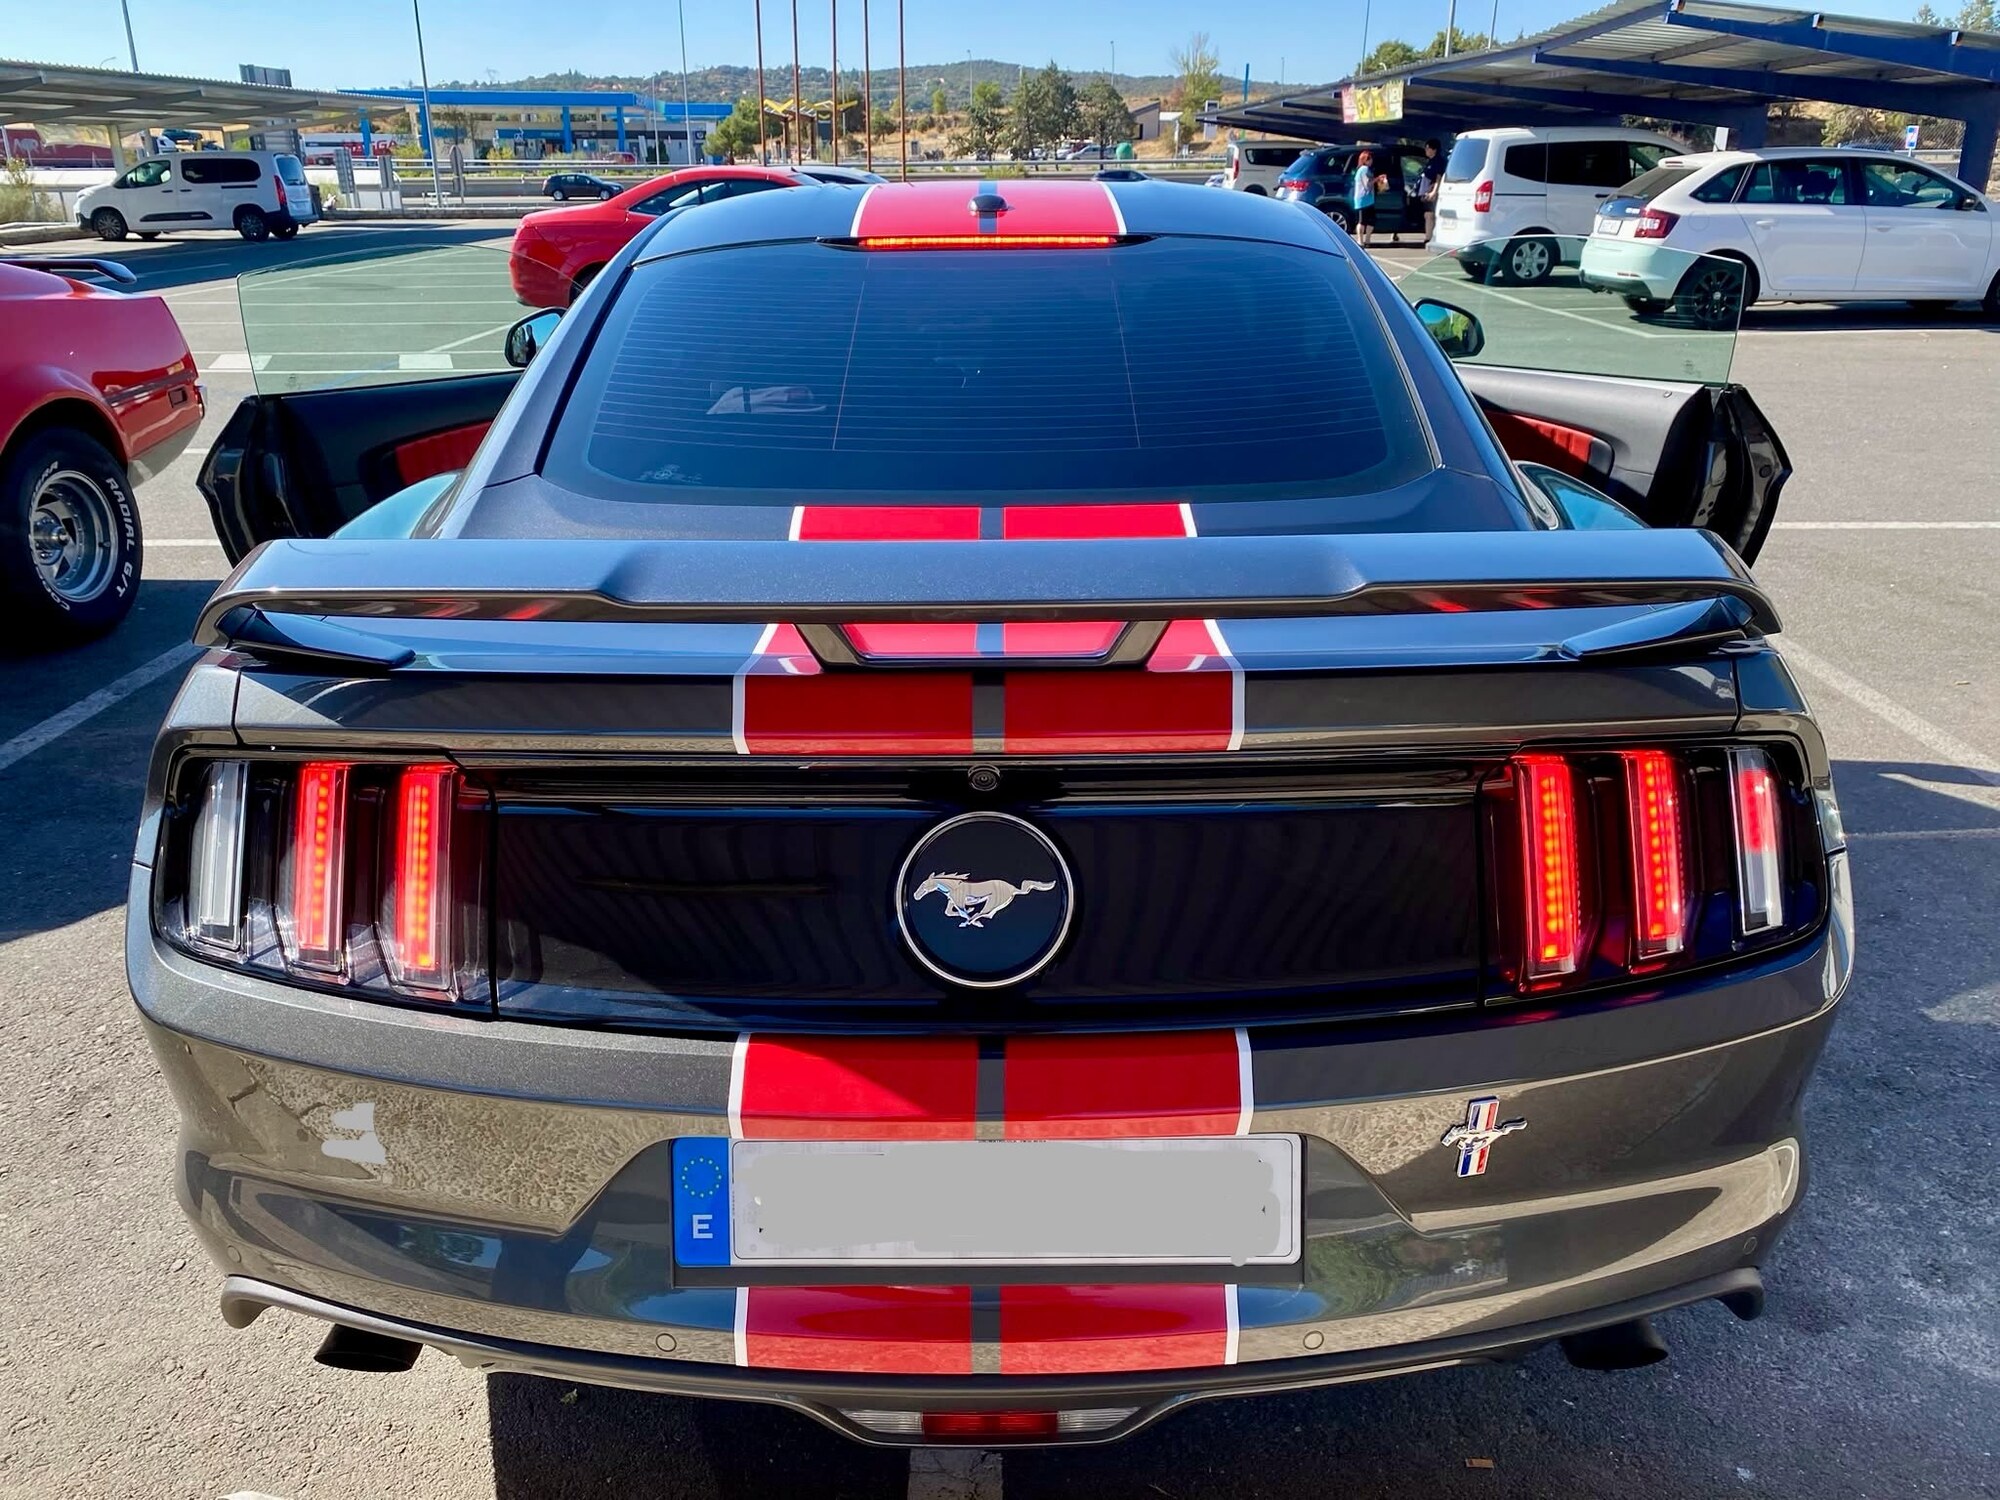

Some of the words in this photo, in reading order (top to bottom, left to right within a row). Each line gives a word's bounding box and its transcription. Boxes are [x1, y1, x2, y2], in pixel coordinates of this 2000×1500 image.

[106, 477, 135, 550] RADIAL
[116, 561, 134, 598] G/T
[692, 1214, 713, 1239] E
